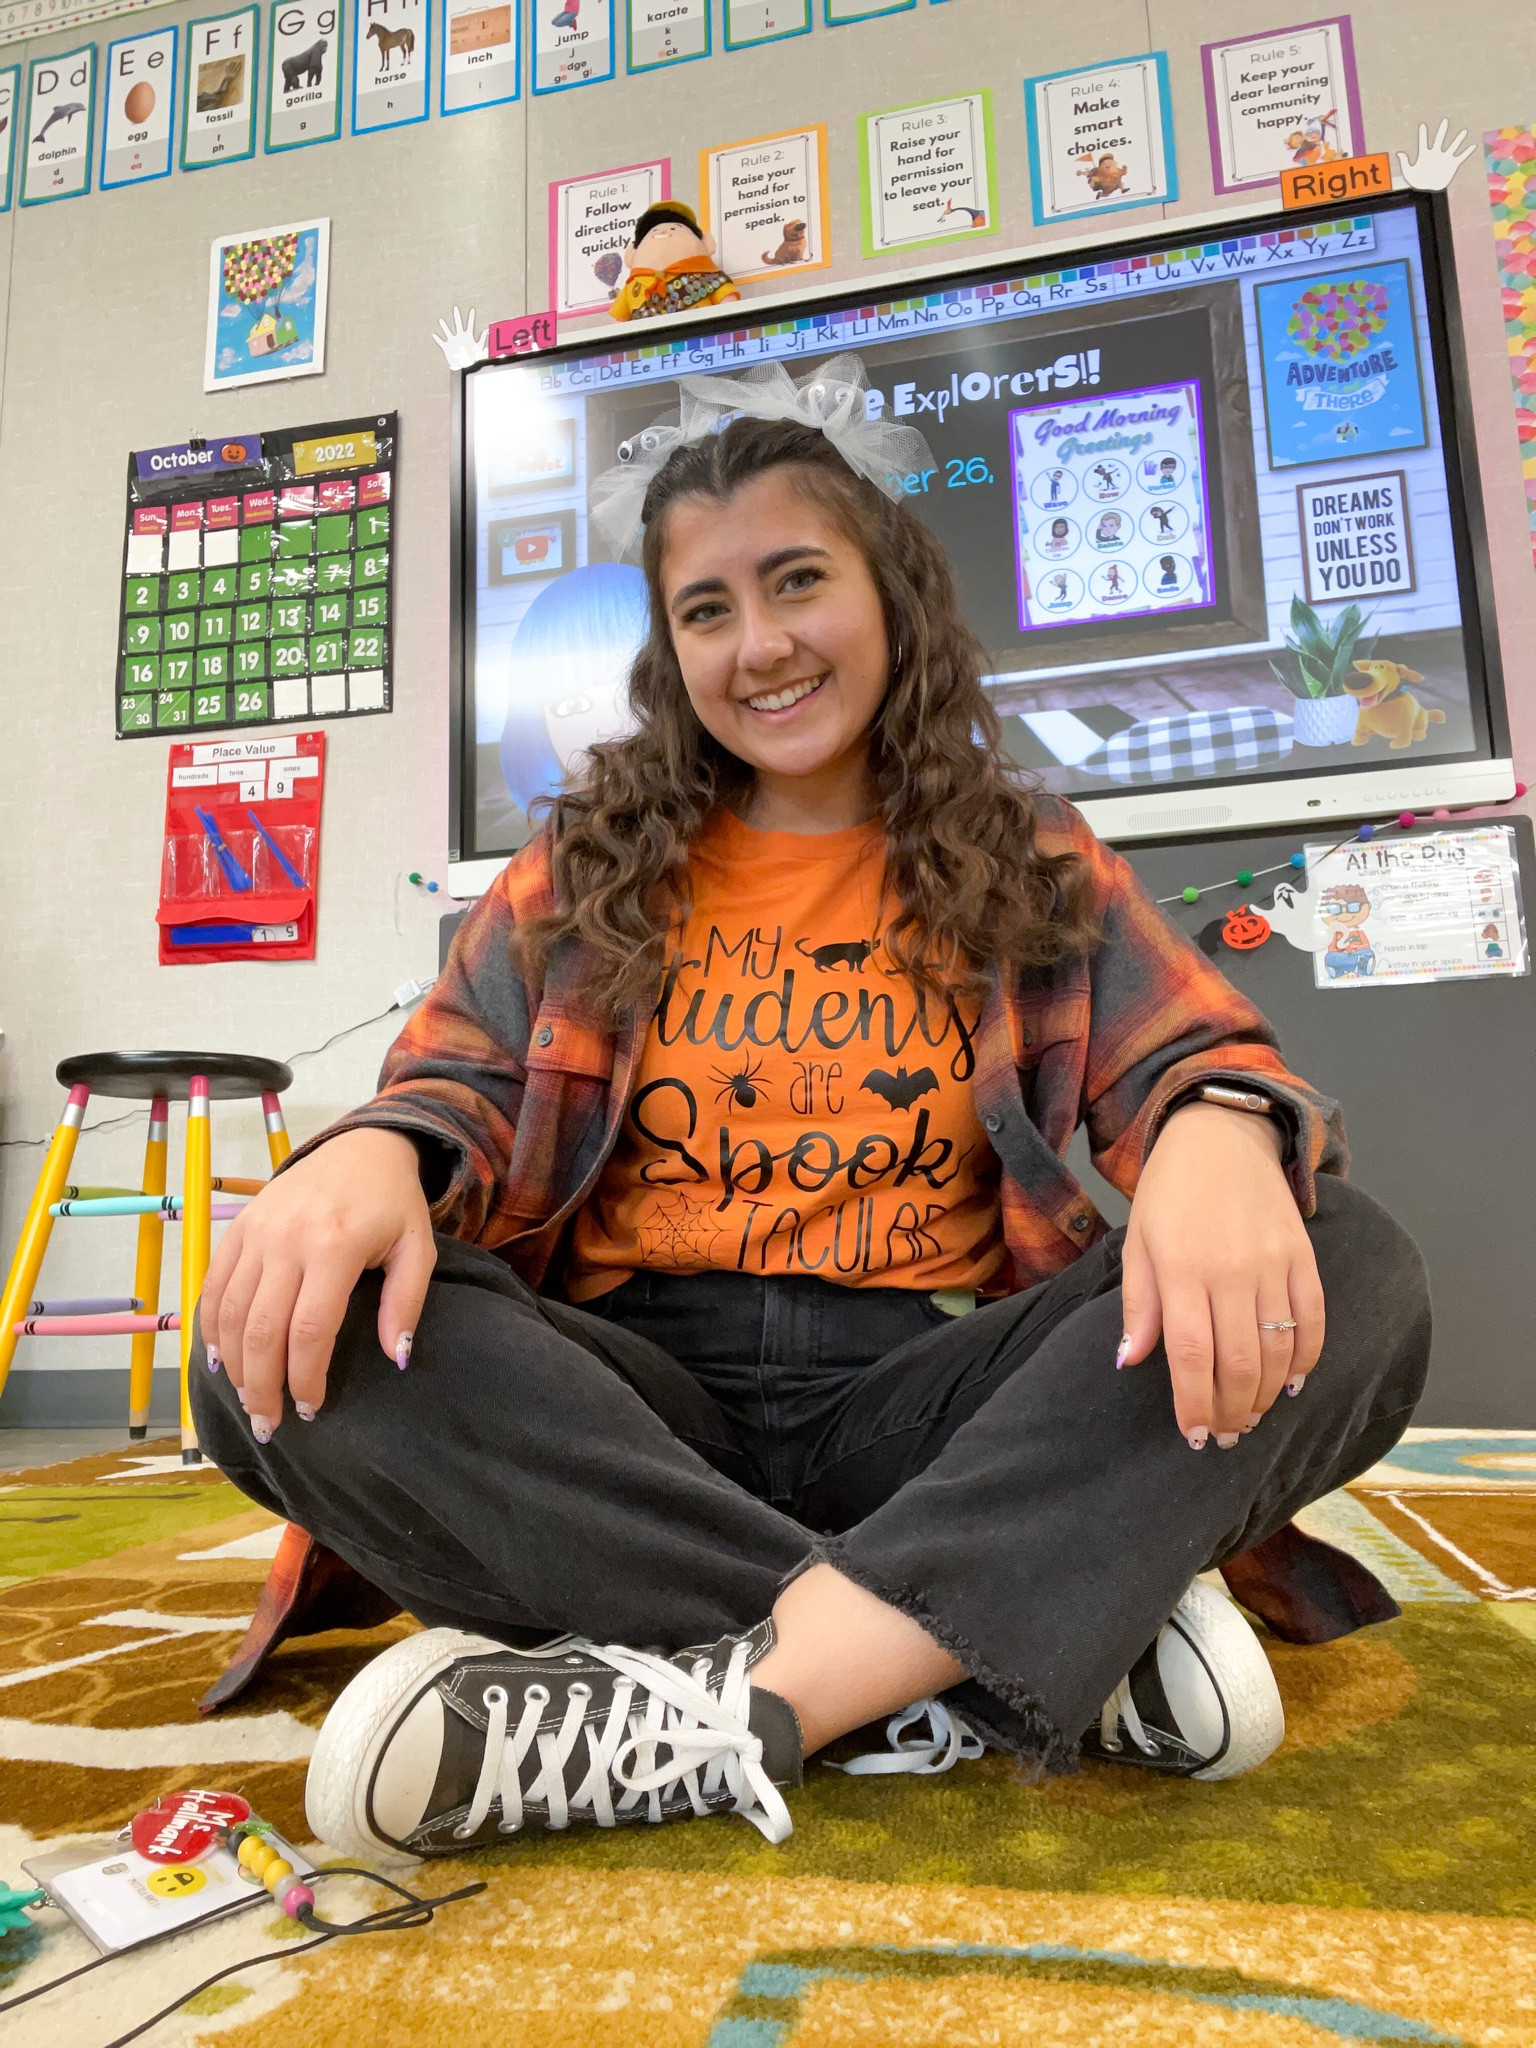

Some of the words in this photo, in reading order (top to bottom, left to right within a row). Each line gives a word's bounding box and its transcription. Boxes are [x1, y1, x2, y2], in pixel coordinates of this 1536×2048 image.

[278, 9, 306, 36] G
[317, 9, 336, 35] g
[647, 6, 689, 23] karate
[206, 28, 221, 55] F
[233, 24, 243, 49] f
[555, 29, 589, 47] jump
[119, 50, 135, 76] E
[147, 51, 164, 69] e
[467, 52, 493, 65] inch
[1250, 49, 1285, 65] Rule
[37, 70, 59, 96] D
[70, 61, 87, 87] d
[374, 71, 407, 85] horse
[1240, 69, 1277, 84] Keep
[1281, 61, 1315, 78] your
[1070, 82, 1104, 98] Rule
[1230, 89, 1264, 102] dear
[1267, 75, 1329, 95] learning
[286, 91, 323, 108] gorilla
[1073, 97, 1120, 116] Make
[1241, 94, 1321, 116] community
[206, 110, 233, 124] fossil
[901, 117, 933, 132] Rule
[1074, 115, 1123, 135] smart
[1257, 113, 1308, 129] happy.
[127, 131, 148, 142] egg
[890, 136, 926, 152] Raise
[929, 130, 961, 147] your
[1067, 137, 1132, 156] choices.
[38, 146, 77, 161] dolphin
[741, 153, 770, 168] Rule
[897, 149, 932, 166] hand
[935, 147, 955, 159] for
[731, 172, 764, 188] Raise
[767, 165, 796, 183] your
[890, 161, 964, 187] permission
[1292, 163, 1383, 200] Right
[589, 185, 618, 200] Rule
[738, 185, 769, 201] hand
[772, 182, 790, 196] for
[884, 188, 898, 201] to
[901, 183, 937, 198] leave
[940, 176, 973, 193] your
[585, 201, 632, 218] Follow
[724, 197, 790, 222] permission
[793, 193, 806, 205] to
[912, 198, 945, 212] seat.
[574, 218, 636, 238] direction
[745, 213, 785, 231] speak.
[540, 375, 562, 391] Bb
[569, 370, 592, 385] Cc
[600, 365, 622, 381] Dd
[631, 360, 651, 375] Ee
[660, 352, 681, 370] Ff
[688, 349, 714, 367] Gg
[722, 342, 745, 359] Hh
[758, 337, 770, 353] Ii
[786, 331, 806, 351] Jj
[816, 325, 839, 341] Kk
[852, 316, 869, 336] Ll
[877, 314, 909, 331] Mm
[914, 308, 938, 325] Nn
[945, 302, 973, 318] Oo
[981, 296, 1005, 315] Pp
[1013, 290, 1042, 307] Qq
[1050, 283, 1073, 301] Rr
[1085, 277, 1108, 294] Ss
[1120, 270, 1143, 287] Tt
[1155, 264, 1181, 281] Uu
[1191, 259, 1216, 273] Vv
[1223, 251, 1257, 268] Ww
[1266, 245, 1294, 262] Xx
[1303, 237, 1329, 256] Yy
[1341, 232, 1368, 249] Zz
[496, 318, 553, 351] Left
[1286, 350, 1399, 386] ADVENTURE
[1033, 411, 1092, 445] Good
[1092, 403, 1183, 432] Morning
[150, 449, 214, 471] October
[315, 442, 356, 464] 2022
[211, 504, 232, 514] Tues.
[249, 496, 271, 508] Wed.
[1312, 487, 1393, 518] DREAMS
[368, 516, 377, 535] 1
[1314, 517, 1352, 537] DON'T
[1355, 512, 1395, 531] WORK
[1316, 531, 1398, 563] UNLESS
[136, 586, 148, 605] 2
[177, 582, 189, 600] 3
[213, 578, 227, 595] 4
[249, 572, 262, 591] 5
[364, 558, 376, 577] 8
[1319, 562, 1367, 591] YOU
[1370, 558, 1401, 585] DO
[137, 625, 150, 644] 9
[169, 621, 190, 641] 10
[205, 617, 223, 636] 11
[241, 612, 261, 631] 12
[277, 607, 300, 627] 13
[319, 603, 341, 623] 14
[358, 597, 379, 616] 15
[131, 665, 153, 683] 16
[168, 660, 188, 680] 17
[202, 656, 222, 676] 18
[239, 651, 260, 671] 19
[275, 647, 301, 667] 20
[315, 643, 337, 663] 21
[353, 637, 379, 657] 22
[122, 698, 136, 710] 23
[159, 693, 174, 705] 24
[197, 696, 221, 716] 25
[238, 691, 263, 712] 26
[136, 714, 150, 726] 30
[173, 710, 187, 722] 31
[212, 745, 242, 758] Place
[245, 743, 276, 756] Value
[178, 772, 209, 781] hundreds
[228, 769, 244, 777] tens
[283, 765, 301, 773] ones
[247, 785, 256, 797] 4
[276, 782, 284, 794] 9
[1346, 851, 1367, 871] At
[650, 951, 982, 1082] tudents
[789, 1060, 844, 1115] are
[630, 1077, 976, 1212] Spook
[737, 1197, 949, 1273] TACULAR
[148, 1789, 221, 1855] Hallmark
[189, 1810, 234, 1834] Ms.
